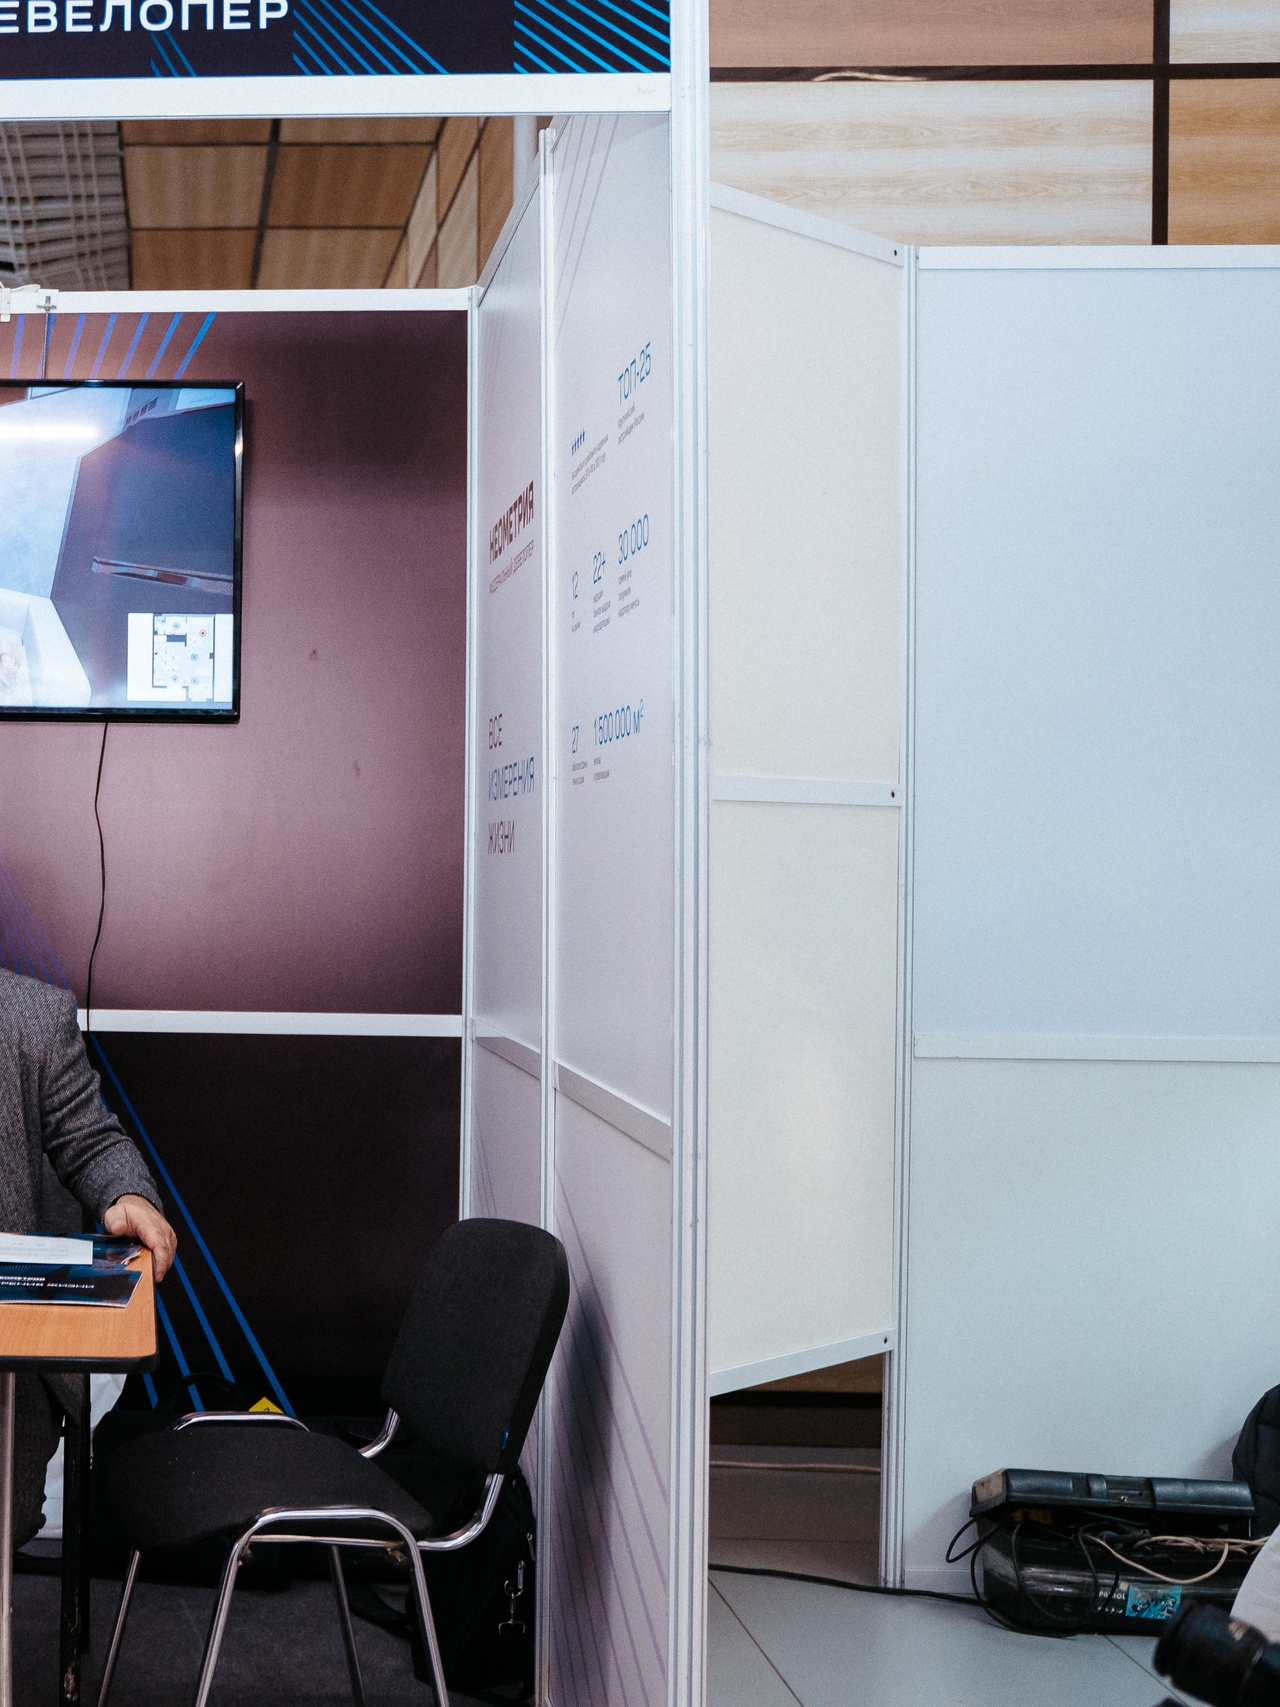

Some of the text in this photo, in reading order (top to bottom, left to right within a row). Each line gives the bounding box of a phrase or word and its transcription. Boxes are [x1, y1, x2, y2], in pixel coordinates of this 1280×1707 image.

[618, 342, 651, 406] ТОП-25
[489, 480, 534, 565] НЕОМЕТРИЯ
[593, 551, 606, 584] 22+
[488, 713, 503, 750] ВСЕ
[571, 725, 579, 753] 27
[488, 756, 535, 802] ИЗМЕРЕНИЯ
[488, 819, 515, 854] ЖИЗНИ
